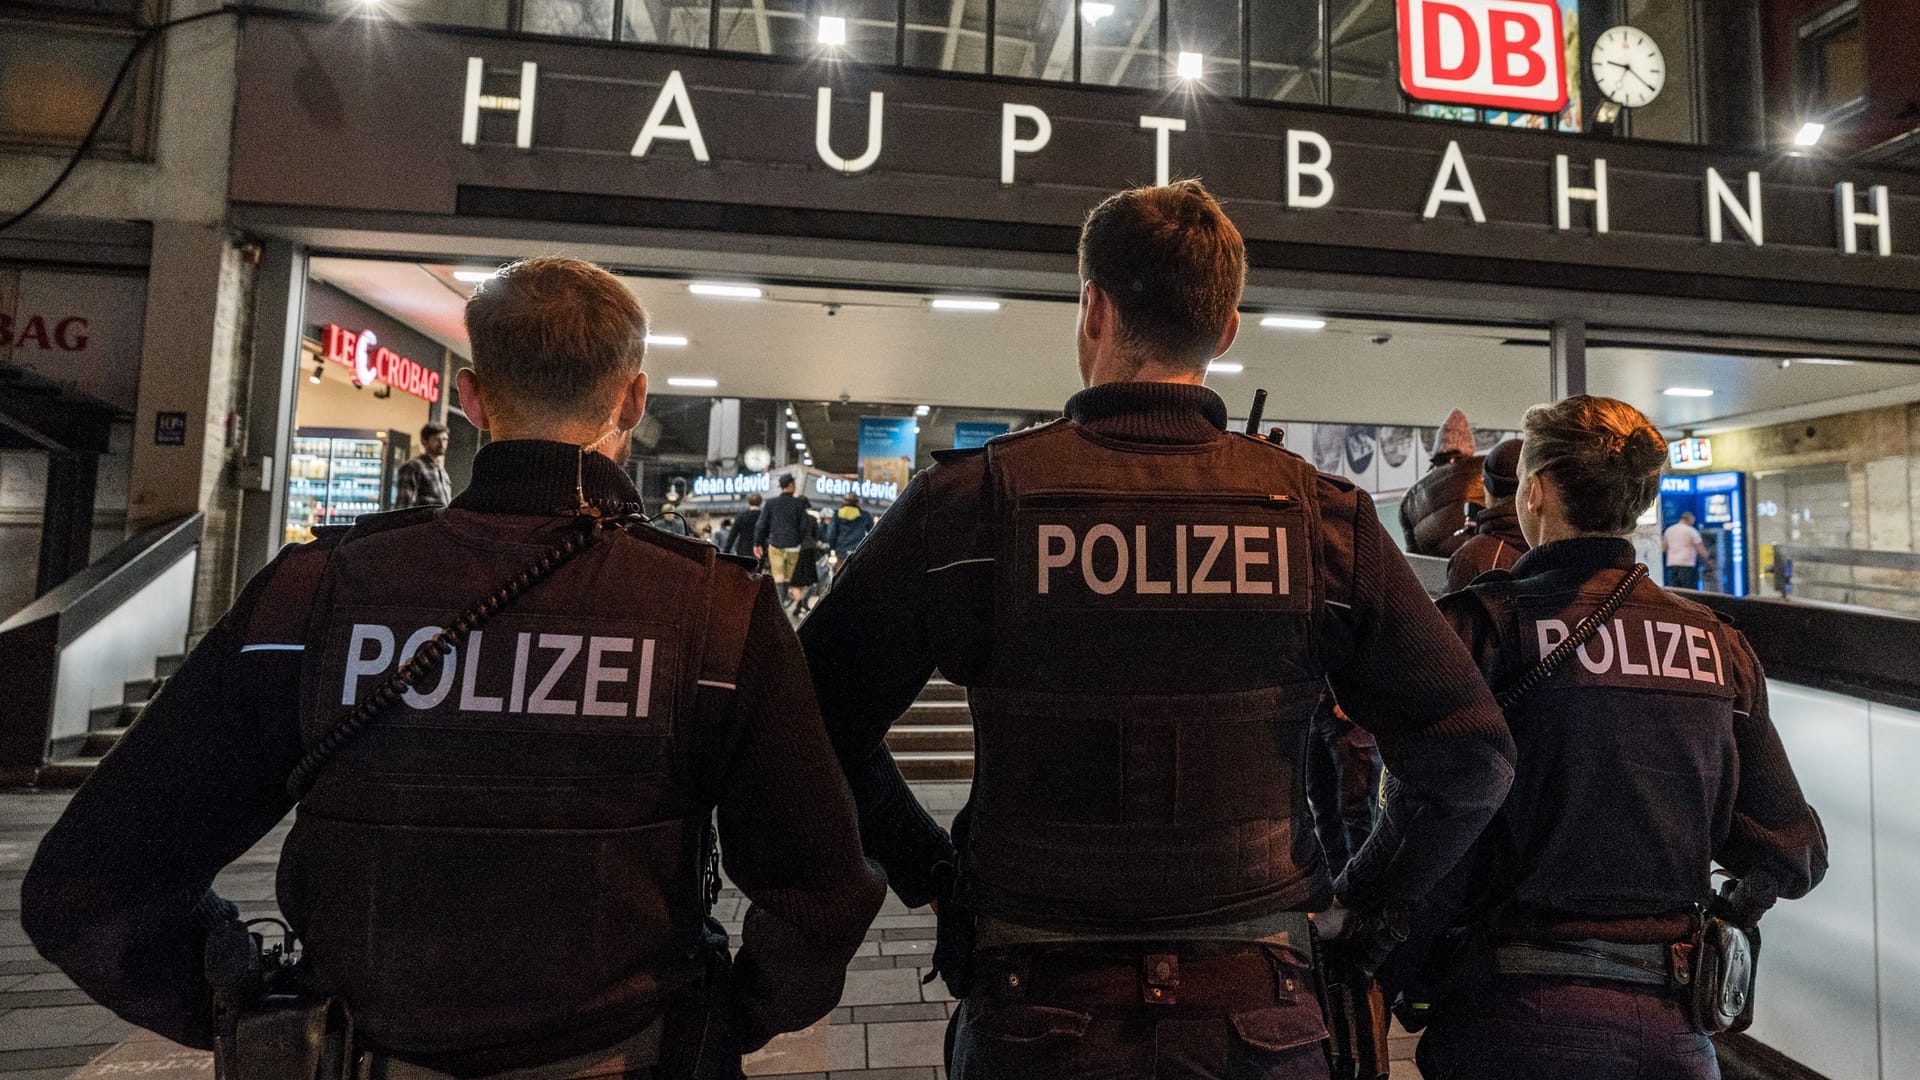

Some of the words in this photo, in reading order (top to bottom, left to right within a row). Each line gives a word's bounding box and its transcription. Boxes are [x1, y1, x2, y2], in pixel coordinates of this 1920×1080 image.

[1422, 1, 1546, 87] DB
[376, 346, 439, 403] CROBAG
[1661, 478, 1690, 491] ATM
[1038, 523, 1290, 595] POLIZEI
[342, 623, 655, 718] POLIZEI
[1536, 617, 1725, 685] POLIZEI
